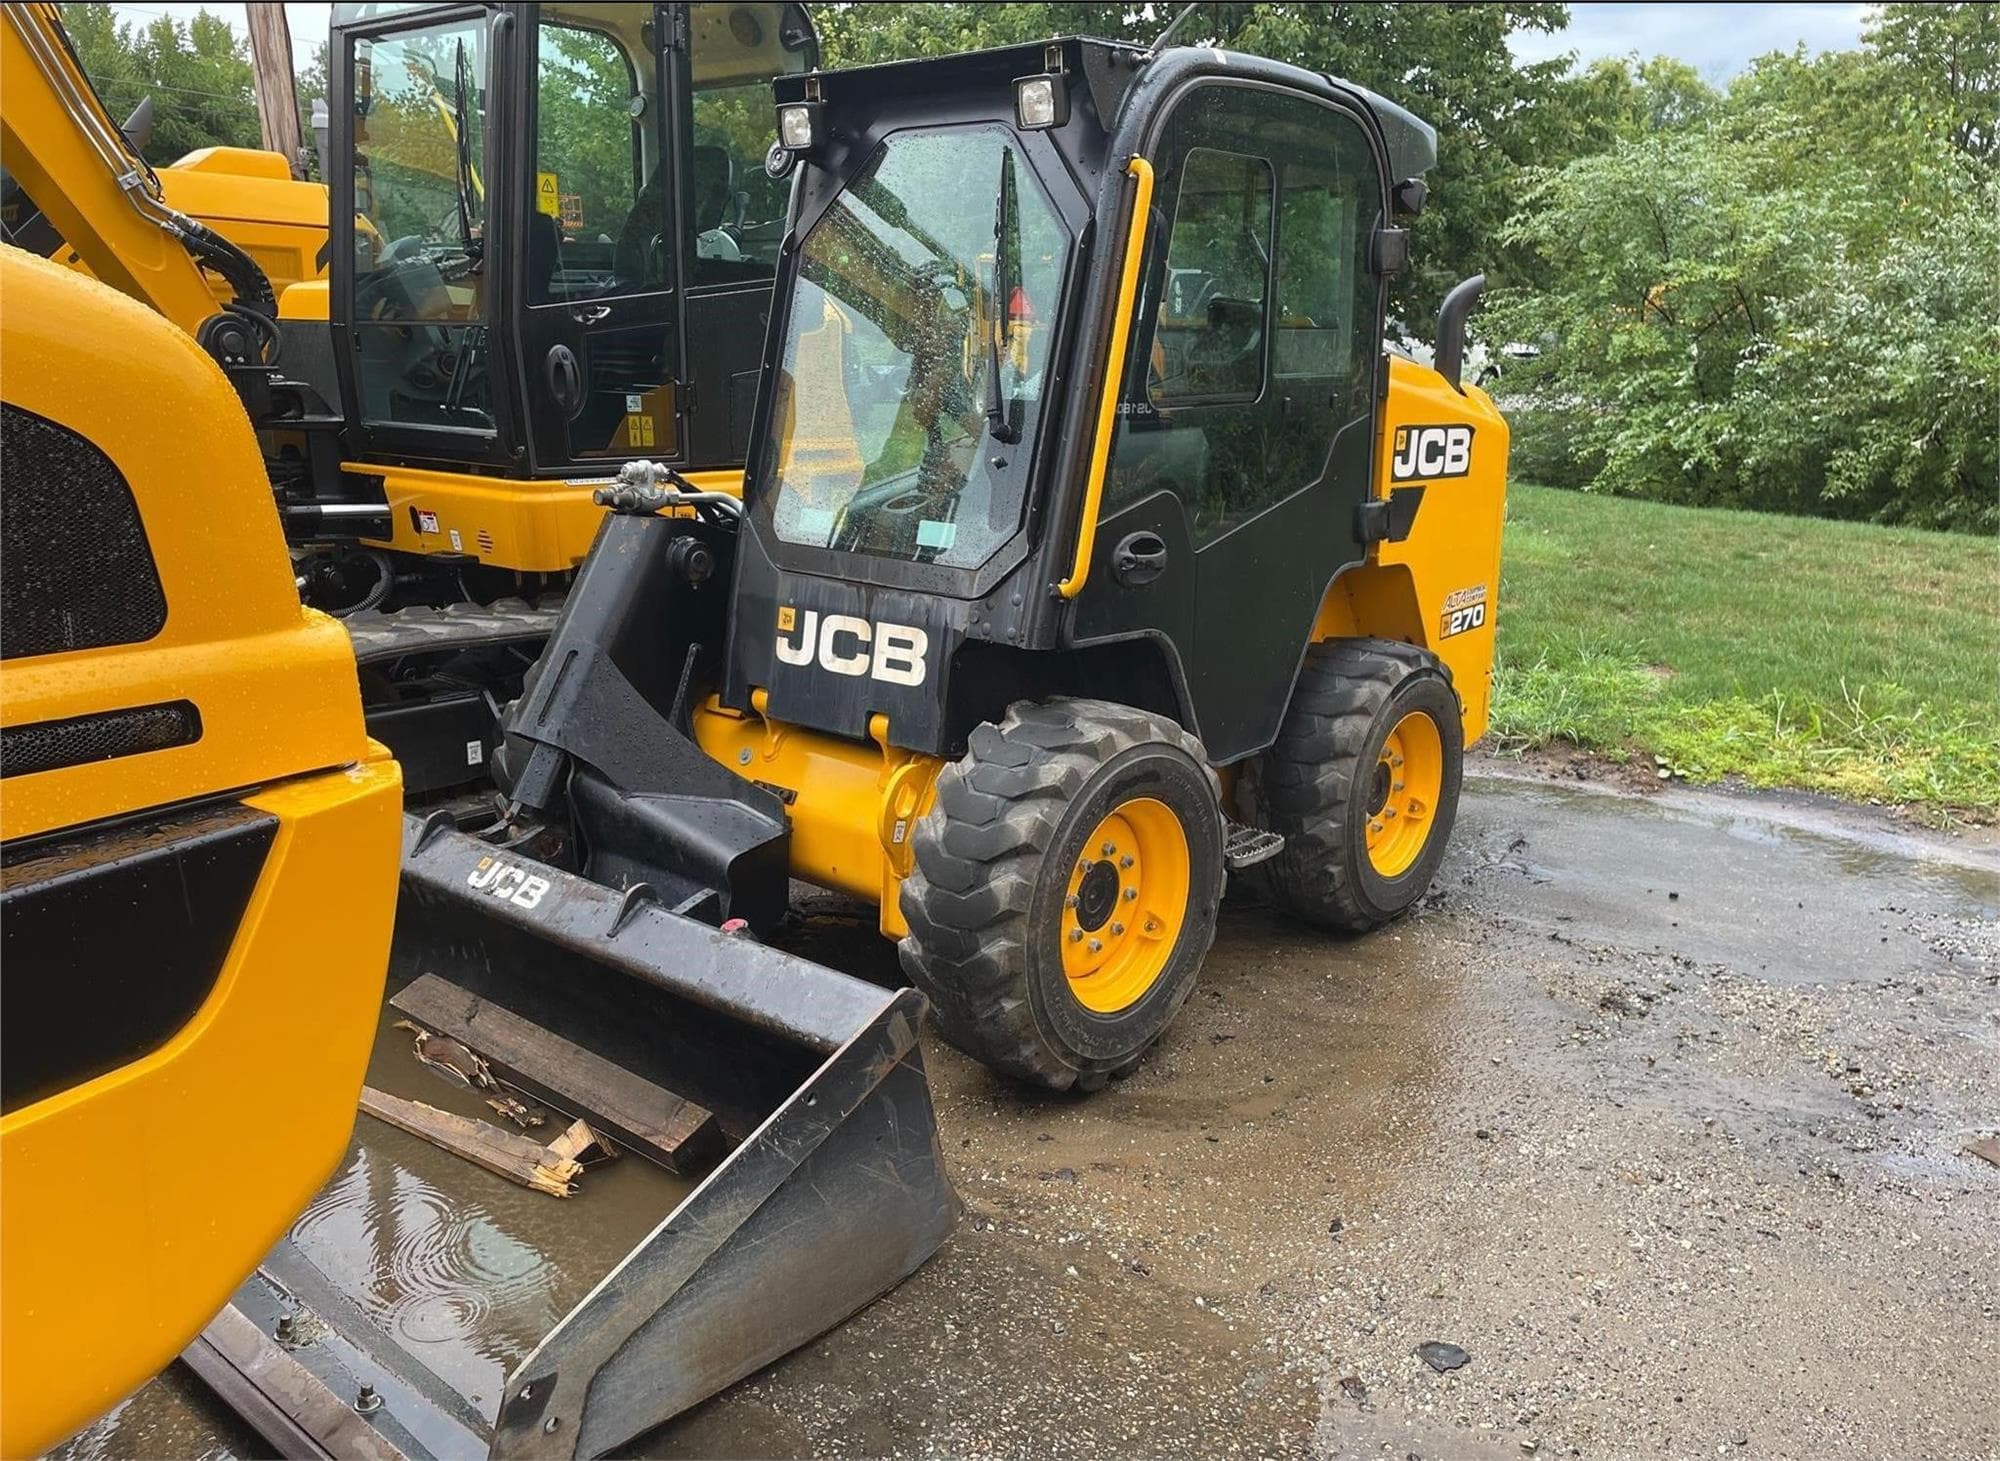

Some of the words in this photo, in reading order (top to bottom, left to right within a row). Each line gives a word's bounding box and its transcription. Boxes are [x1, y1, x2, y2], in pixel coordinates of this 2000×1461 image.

[1394, 428, 1471, 478] JCB
[1442, 589, 1468, 610] ALTA
[1450, 604, 1485, 635] 270
[776, 610, 928, 687] JCB
[467, 861, 550, 909] JCB
